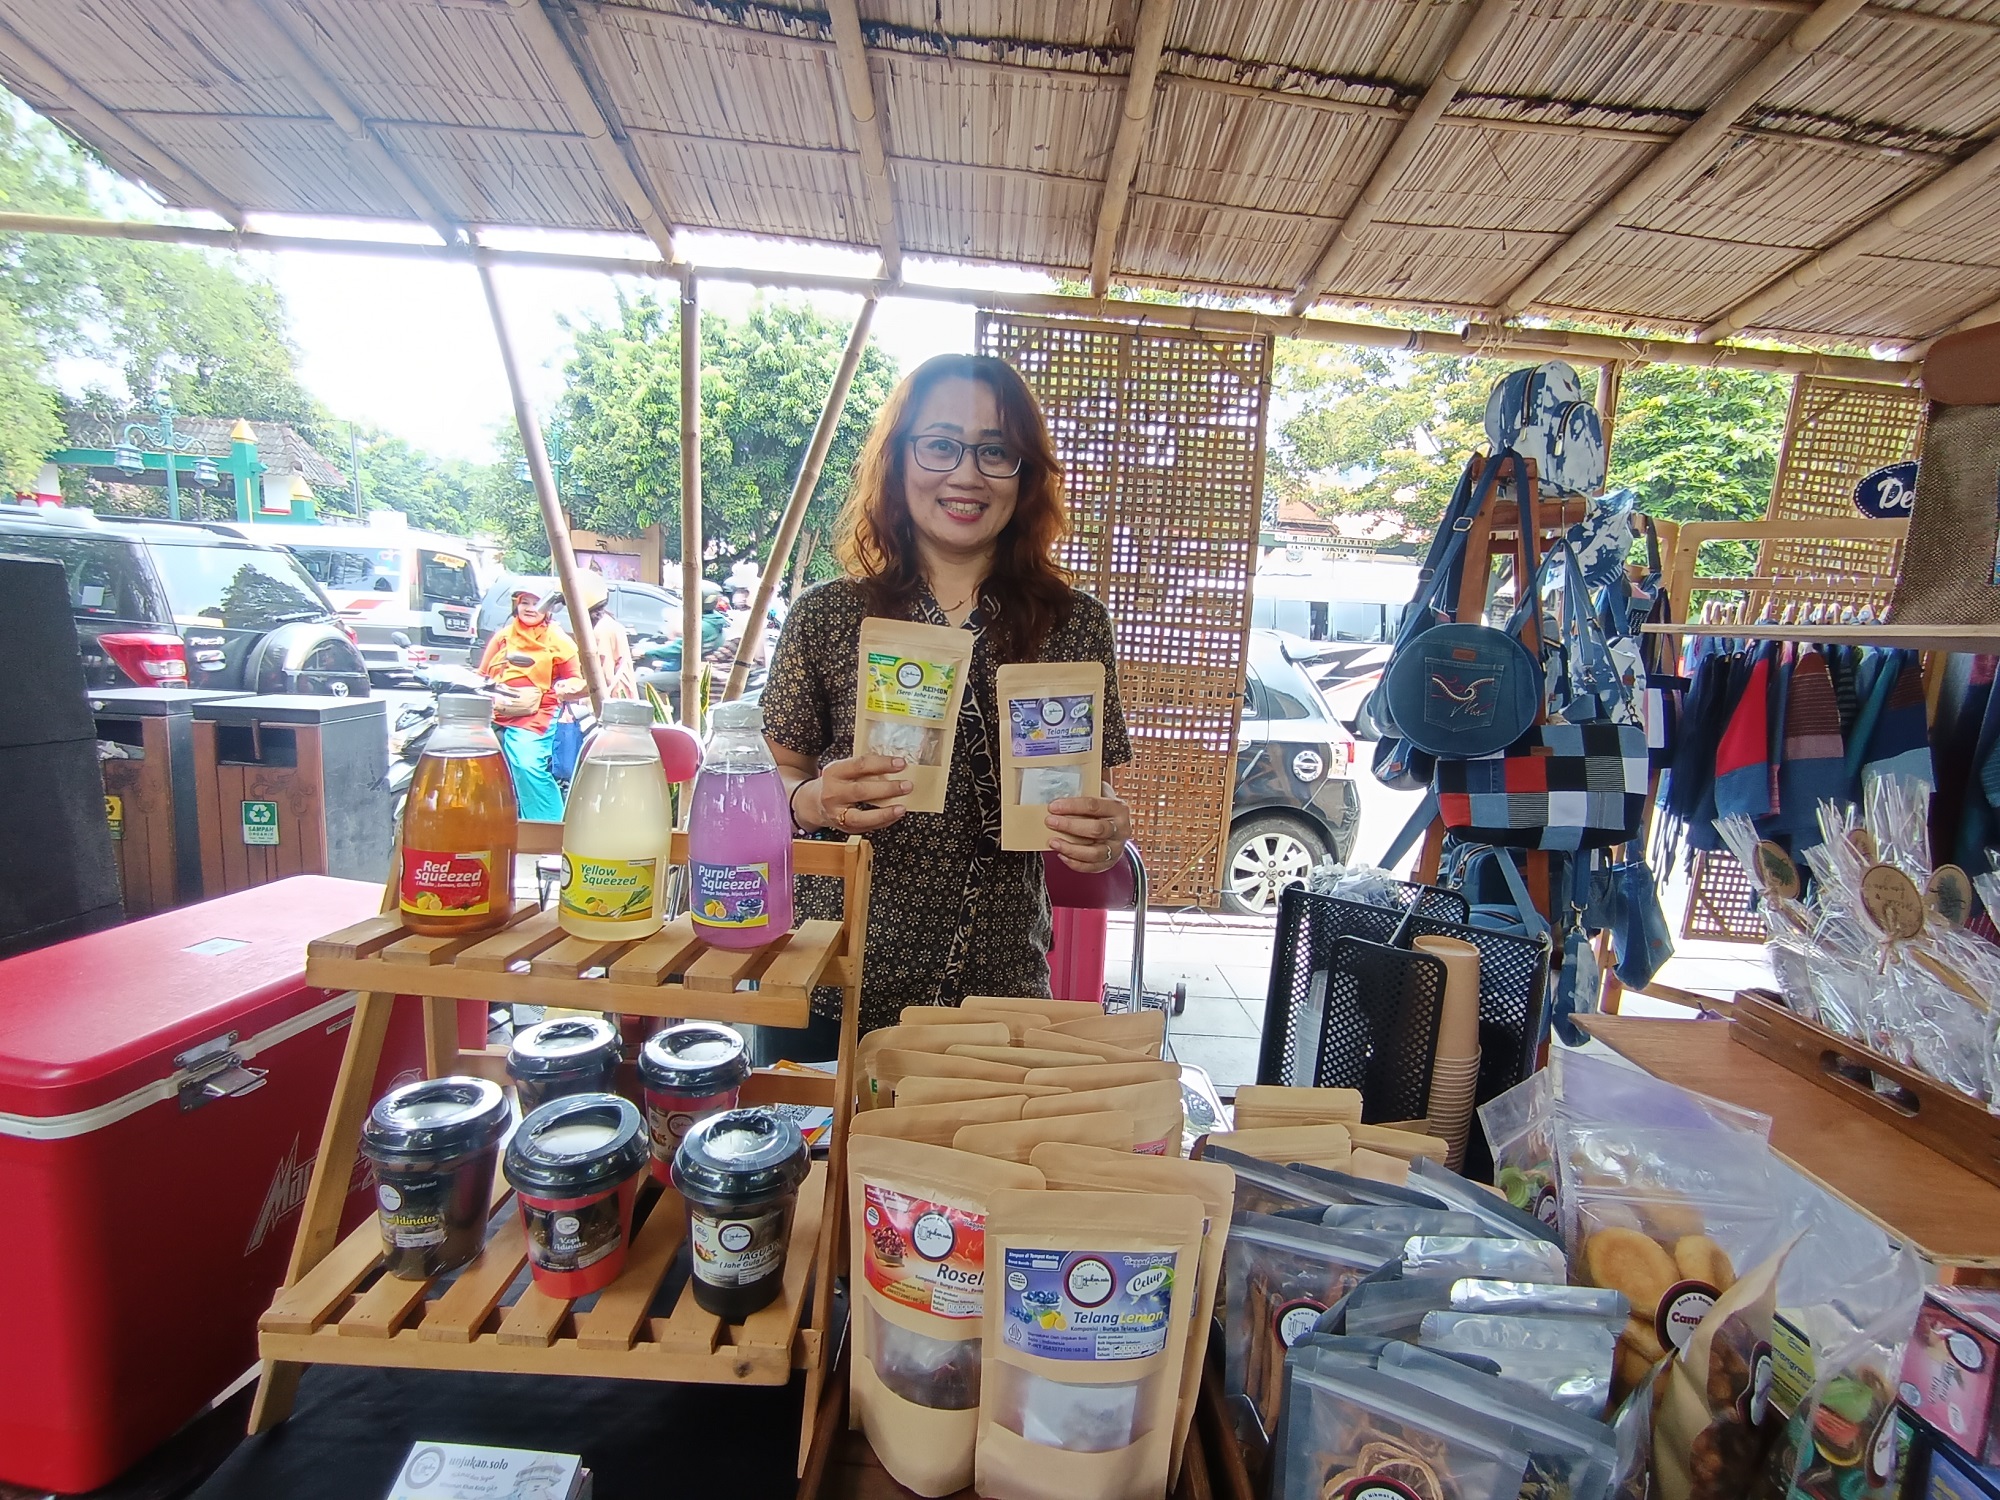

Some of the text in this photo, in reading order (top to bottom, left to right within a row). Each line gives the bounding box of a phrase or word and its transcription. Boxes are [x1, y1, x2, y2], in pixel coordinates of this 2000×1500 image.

[423, 860, 451, 873] Red
[581, 864, 617, 876] Yellow
[698, 865, 736, 880] Purple
[415, 868, 482, 883] Squeezed
[583, 874, 638, 886] Squeezed
[701, 876, 761, 891] Squeezed
[560, 1236, 581, 1244] Kopi
[724, 1261, 742, 1269] Jahe
[742, 1258, 760, 1268] Gula
[937, 1263, 984, 1286] Rosel
[1132, 1271, 1163, 1292] Celup
[1074, 1310, 1164, 1326] Telang Lemon
